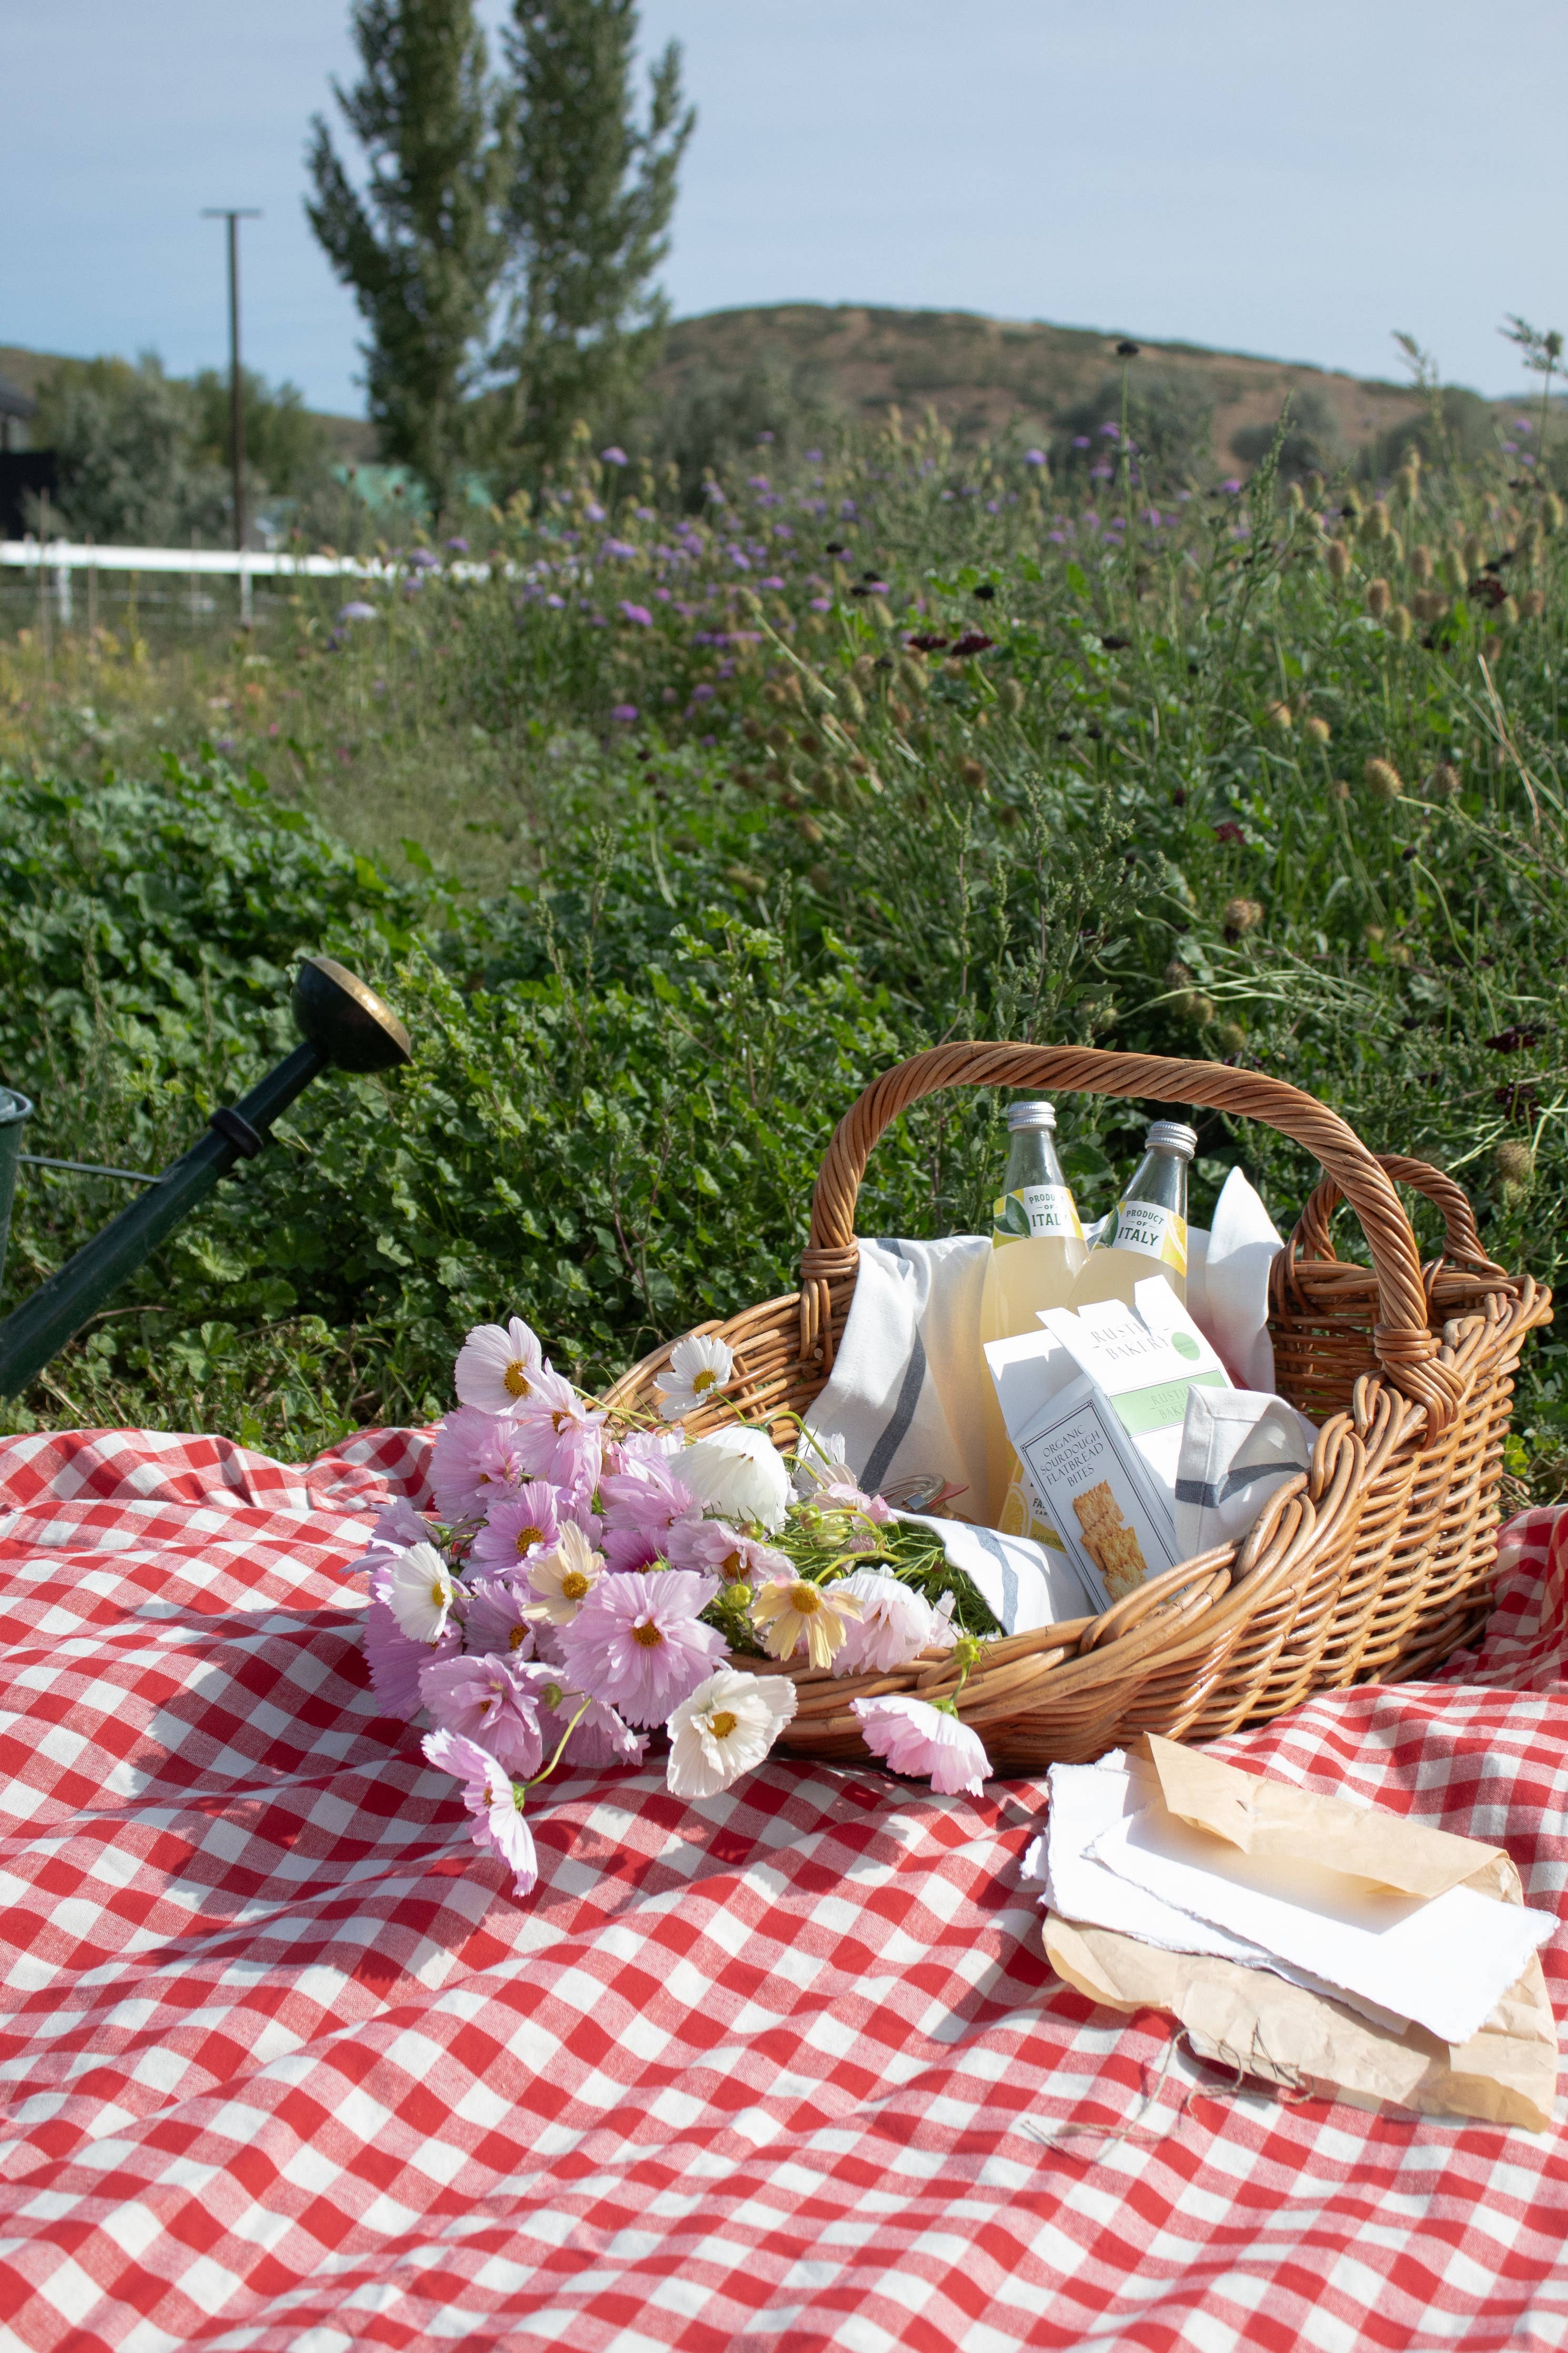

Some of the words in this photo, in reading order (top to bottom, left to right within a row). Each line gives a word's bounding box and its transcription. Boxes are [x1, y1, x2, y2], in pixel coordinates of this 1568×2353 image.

[1029, 1193, 1064, 1204] PRODU
[1031, 1213, 1067, 1227] ITAL
[1126, 1210, 1165, 1224] PRODUCT
[1118, 1227, 1159, 1246] ITALY
[1091, 1323, 1152, 1342] RUSTI
[1043, 1425, 1086, 1457] ORGANIC
[1040, 1431, 1100, 1475] SOURDOUGH
[1047, 1443, 1104, 1485] FLATBREAD
[1067, 1464, 1094, 1486] BITES
[1032, 1498, 1045, 1509] FA
